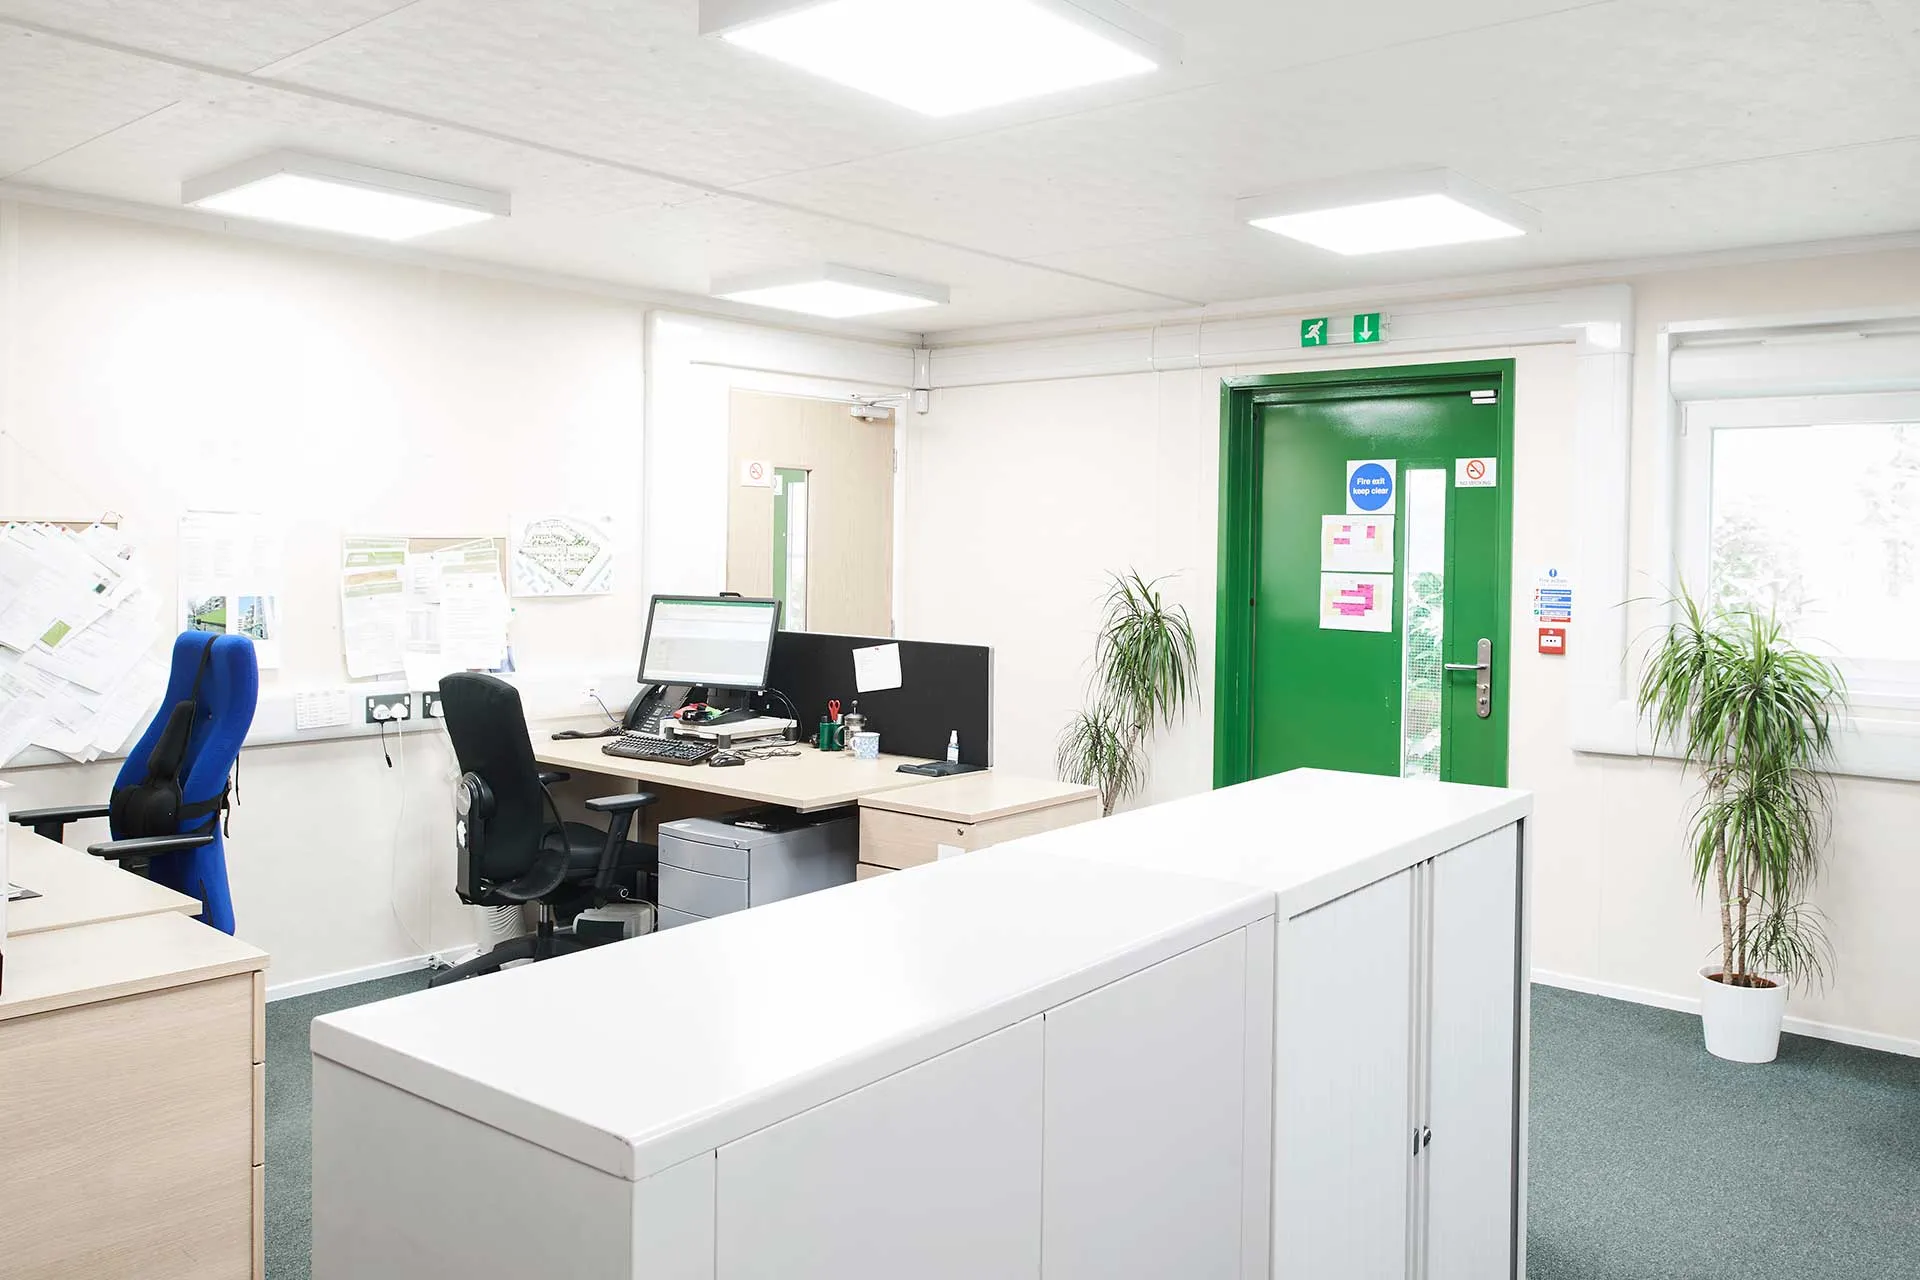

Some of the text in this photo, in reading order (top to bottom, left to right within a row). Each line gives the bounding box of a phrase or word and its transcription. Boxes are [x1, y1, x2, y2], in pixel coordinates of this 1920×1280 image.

[1357, 477, 1385, 485] Fire exit
[1353, 487, 1389, 496] keep clear
